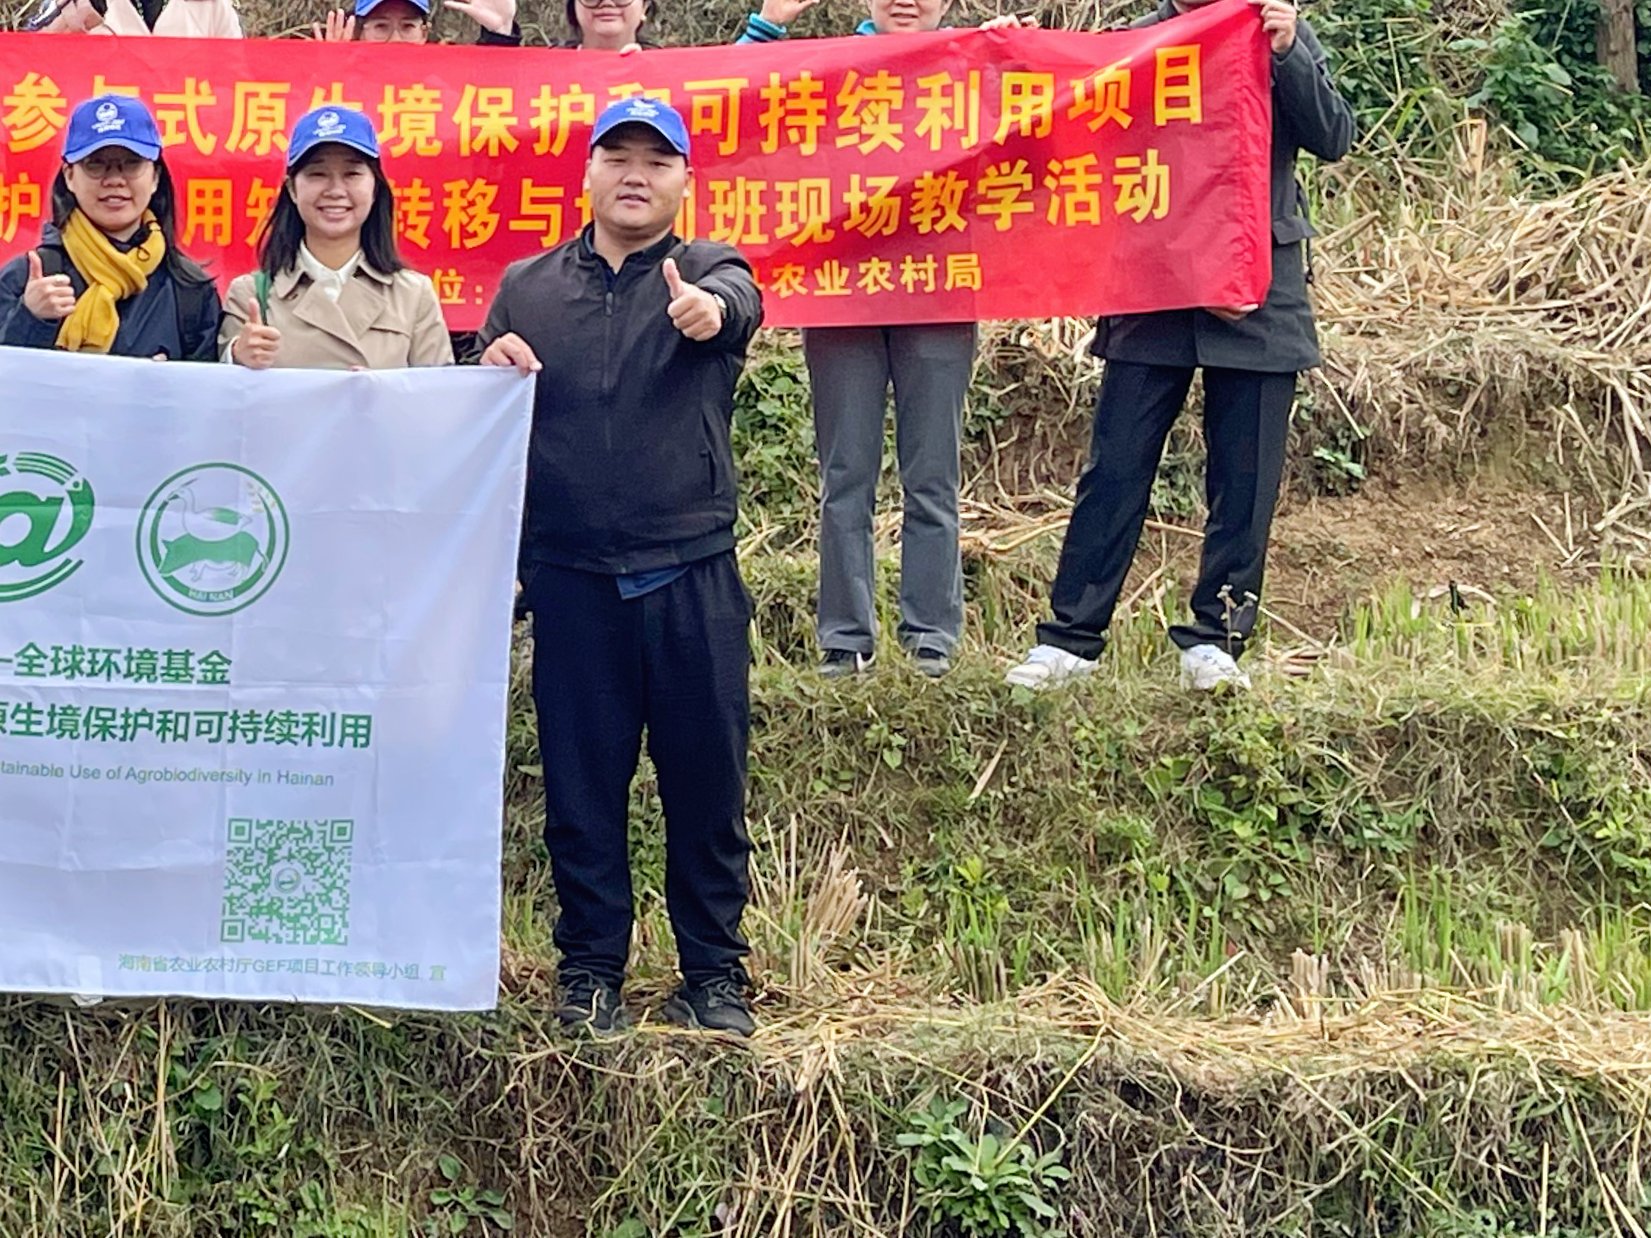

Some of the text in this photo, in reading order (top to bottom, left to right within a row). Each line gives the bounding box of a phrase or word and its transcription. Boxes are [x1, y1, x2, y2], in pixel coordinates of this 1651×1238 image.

[753, 253, 982, 299] 农业农村局
[69, 764, 101, 780] Use
[106, 764, 123, 780] of
[125, 765, 253, 787] Agrobiodiversity
[277, 770, 334, 787] Hainan
